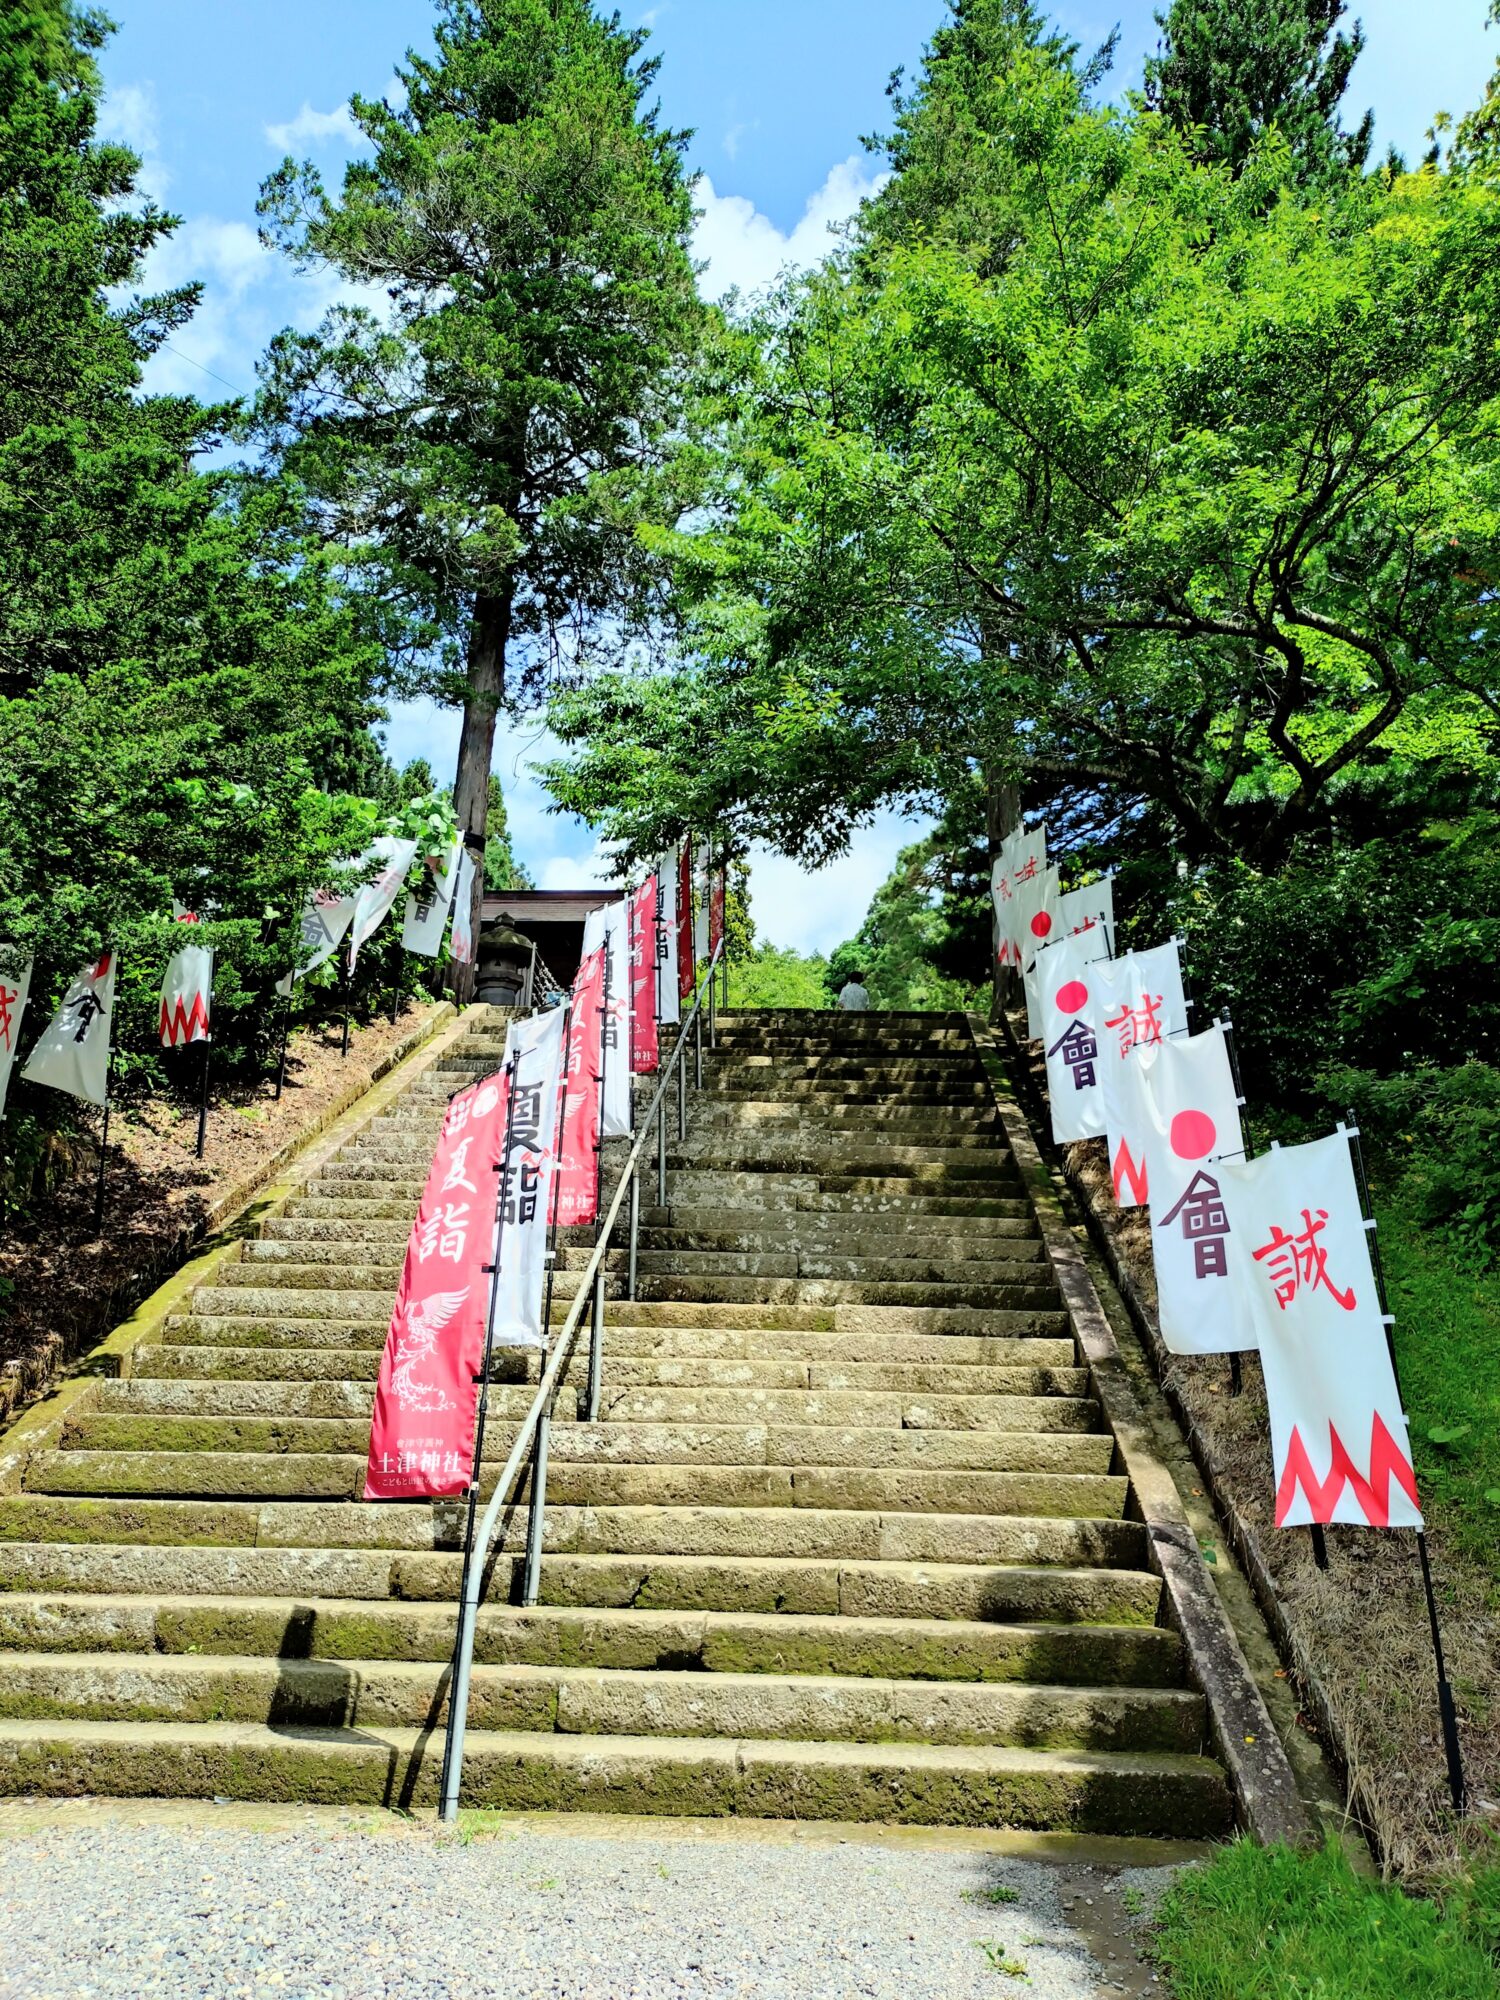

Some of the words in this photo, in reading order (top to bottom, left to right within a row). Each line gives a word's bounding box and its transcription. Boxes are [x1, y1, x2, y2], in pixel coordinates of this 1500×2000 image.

[1047, 1019, 1098, 1091] 會
[1104, 993, 1164, 1060] 誠
[419, 1136, 477, 1264] 夏詣
[1158, 1169, 1231, 1279] 會
[1252, 1208, 1357, 1311] 誠
[376, 1451, 463, 1474] 土津神社
